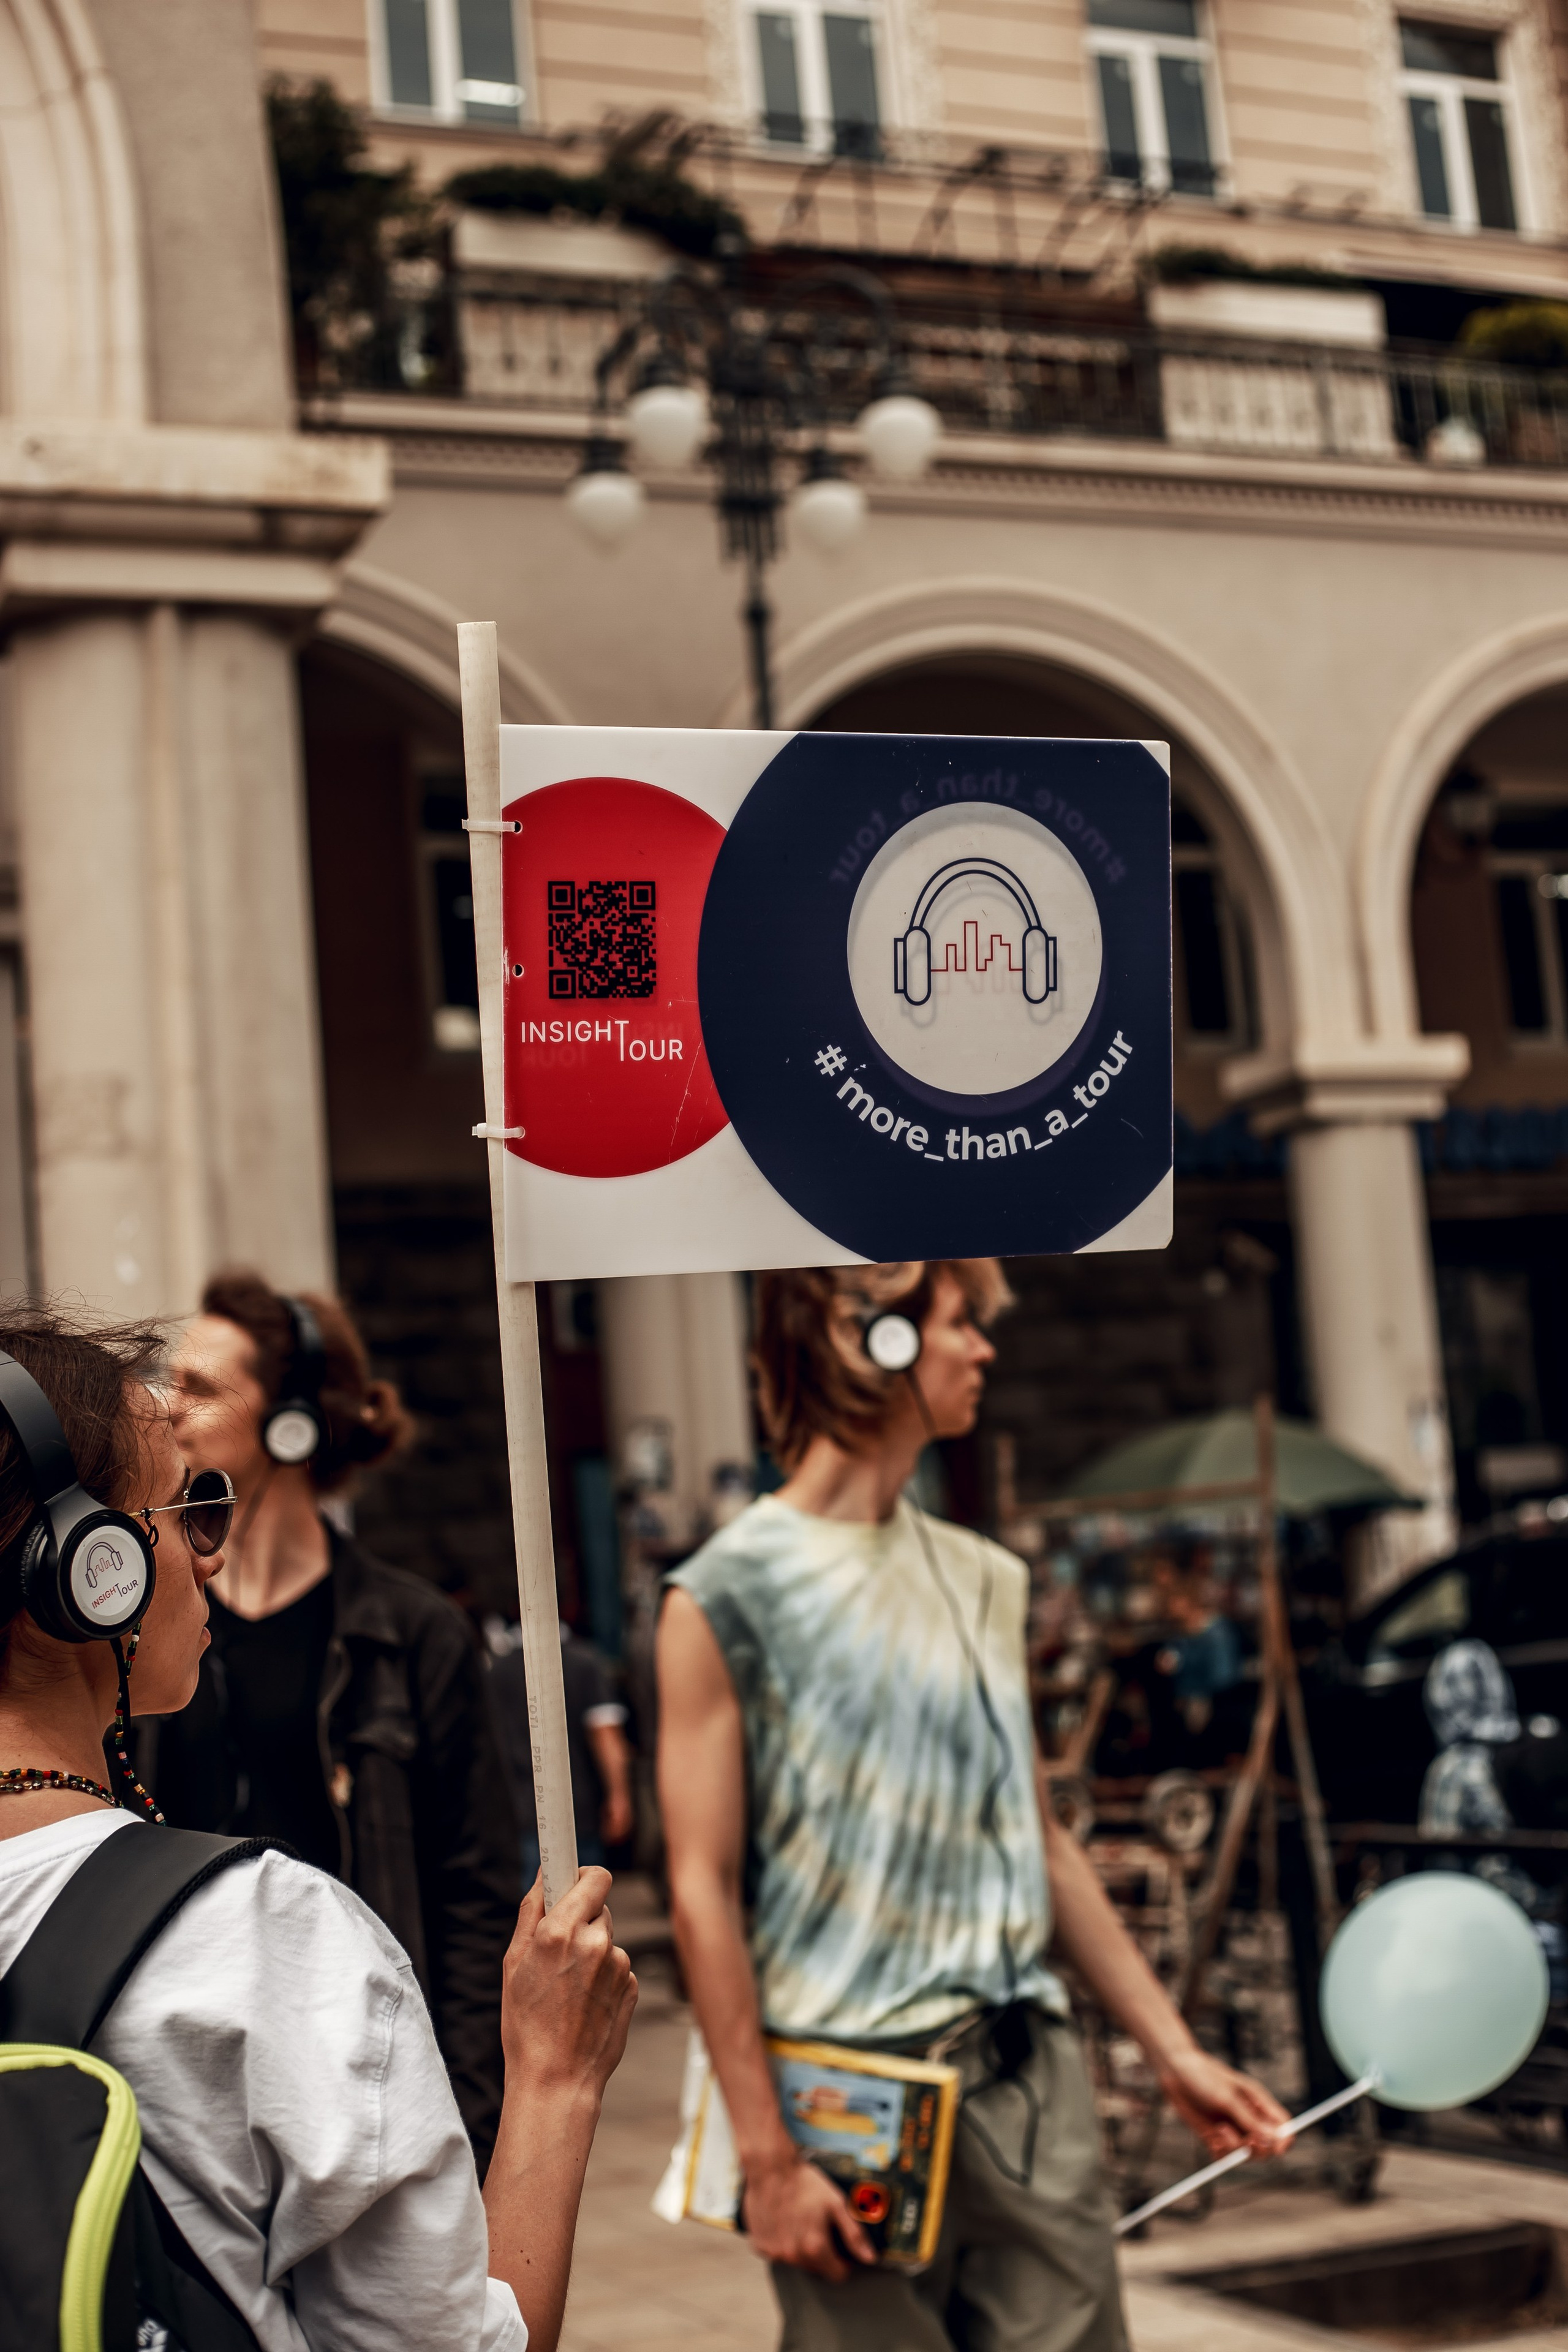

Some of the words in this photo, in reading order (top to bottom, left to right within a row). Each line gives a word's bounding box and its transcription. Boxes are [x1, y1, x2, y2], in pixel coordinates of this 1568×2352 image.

[813, 1029, 1134, 1162] #more_than_a_tour
[528, 1695, 538, 1728] TOTI
[532, 1746, 543, 1773] PPR
[535, 1785, 545, 1803] PN
[538, 1815, 547, 1830] 16
[540, 1847, 549, 1863] 20
